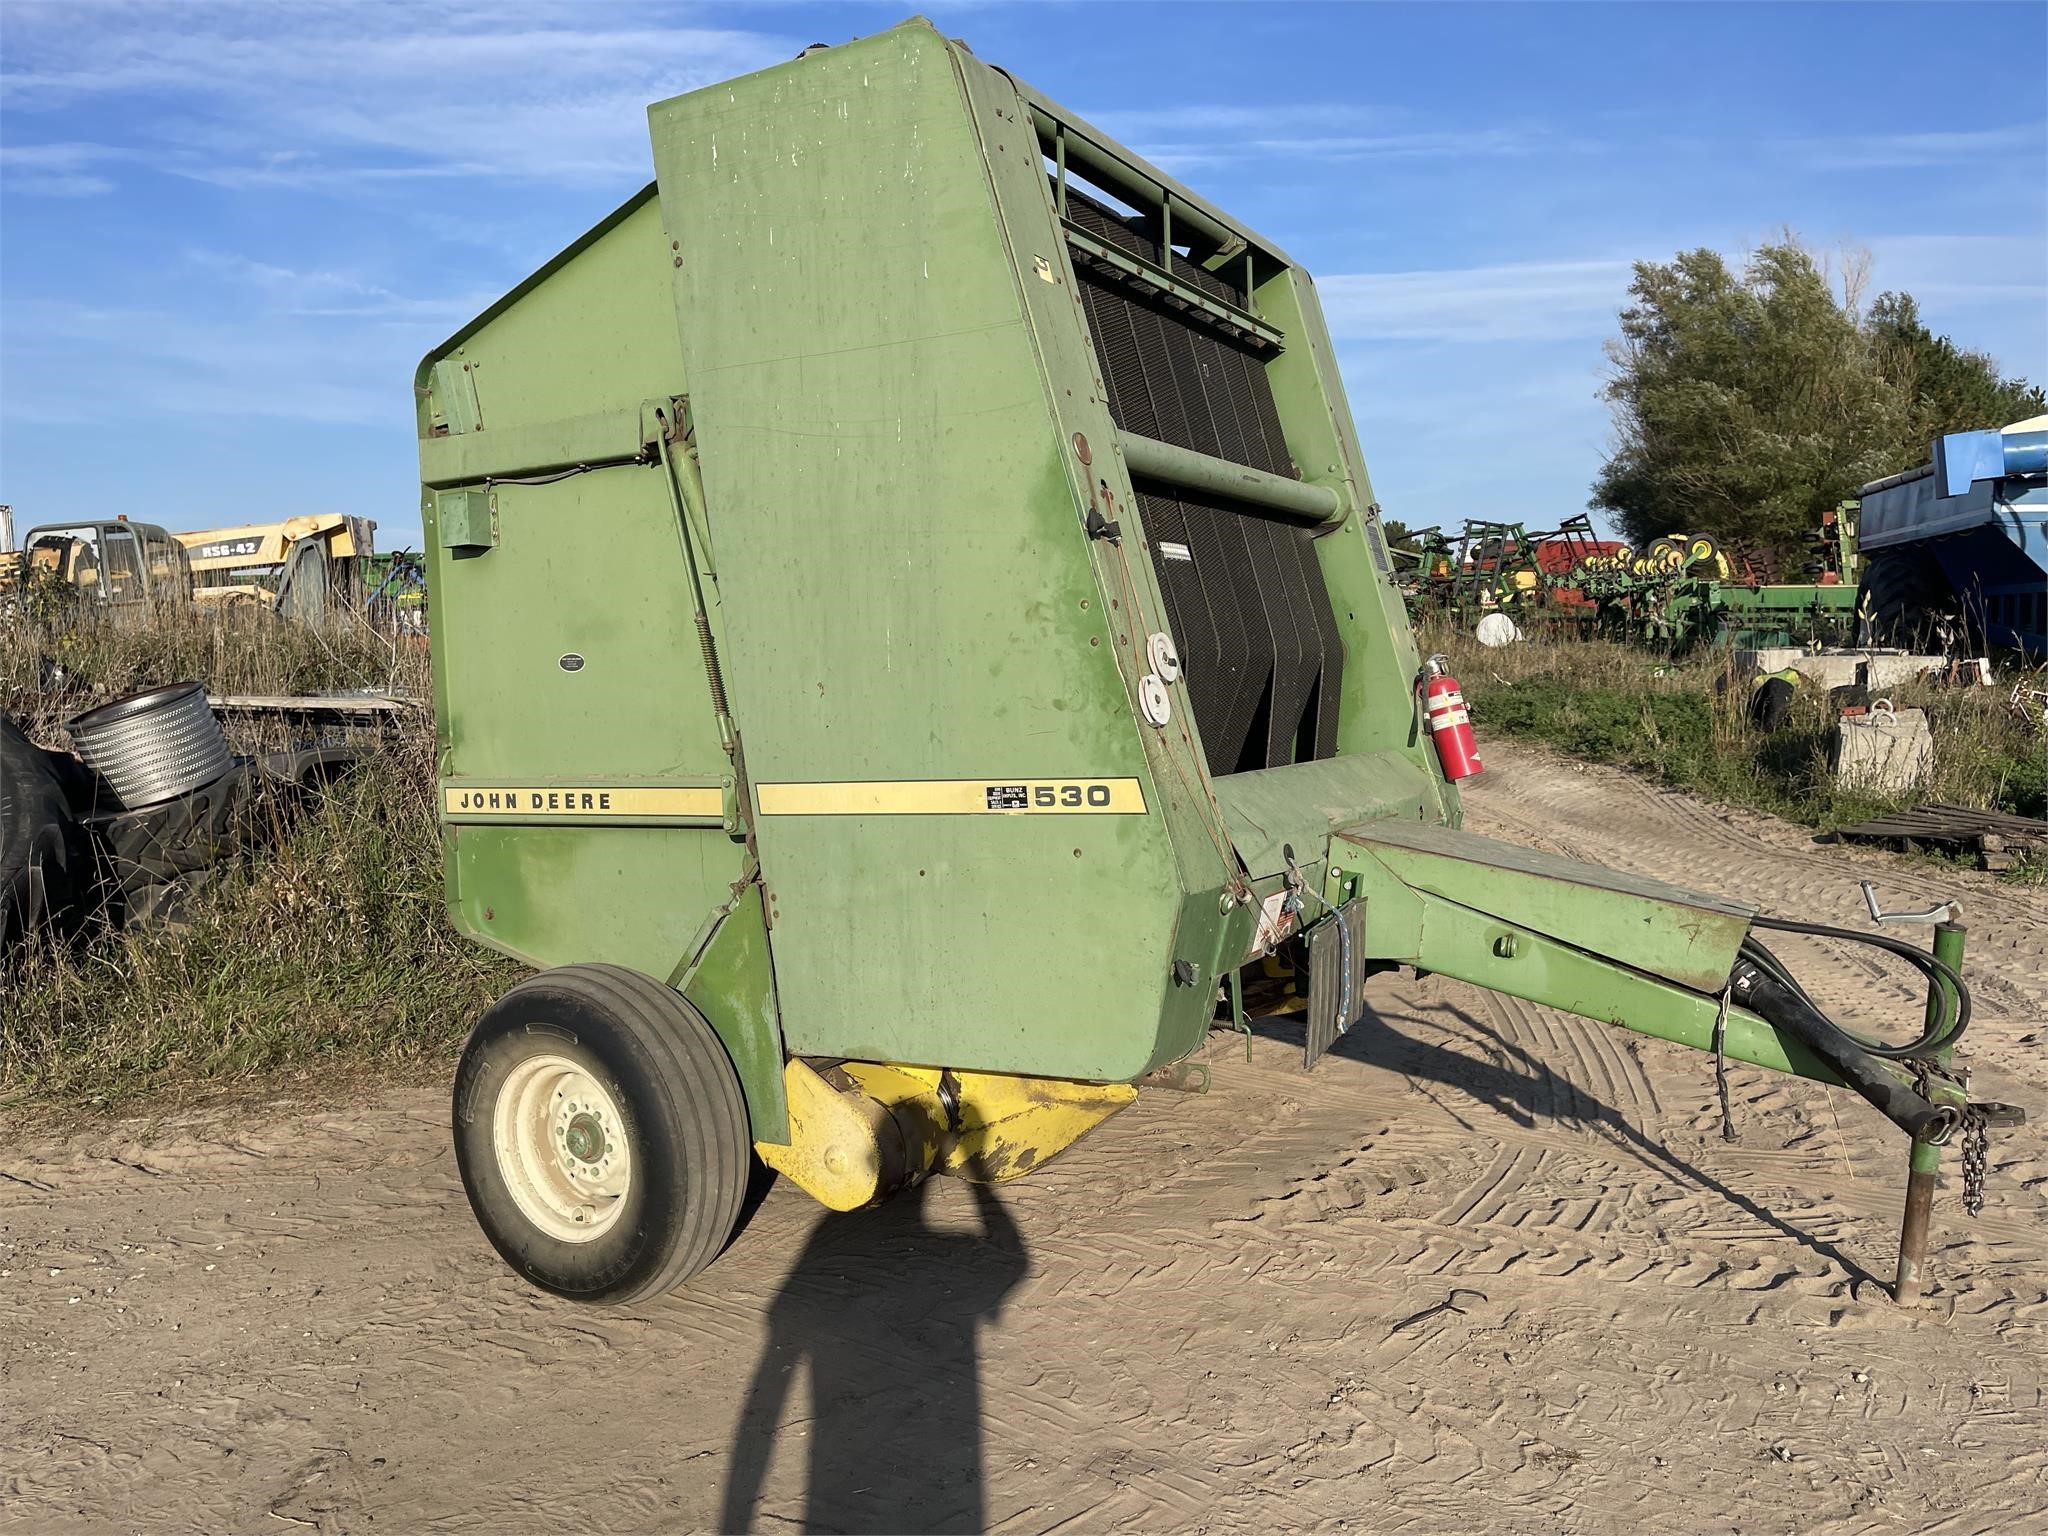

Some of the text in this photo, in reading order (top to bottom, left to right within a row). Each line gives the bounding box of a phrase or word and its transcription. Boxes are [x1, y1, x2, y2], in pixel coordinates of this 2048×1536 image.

[461, 793, 610, 809] JOHN DEERE
[1034, 785, 1111, 807] 530
